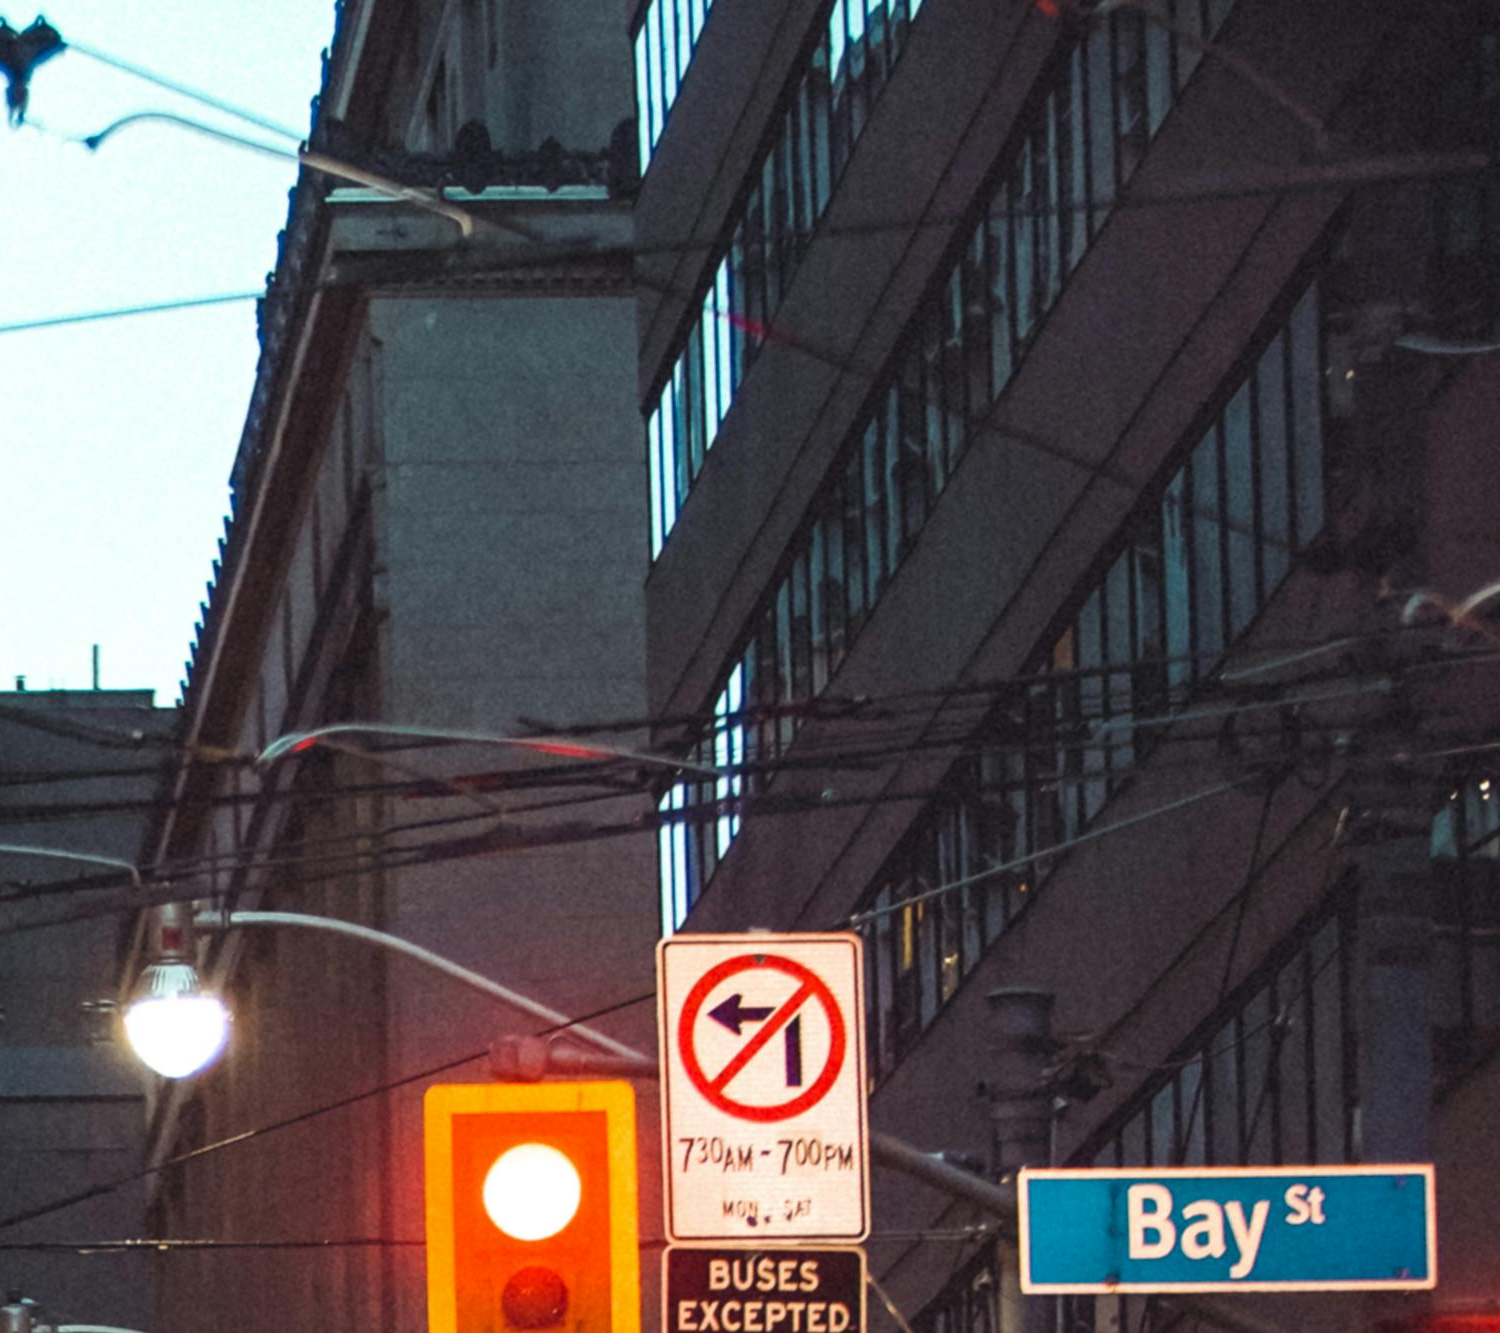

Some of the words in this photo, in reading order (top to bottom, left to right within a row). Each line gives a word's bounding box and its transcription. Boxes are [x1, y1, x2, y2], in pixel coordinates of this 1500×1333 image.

[678, 1137, 754, 1173] 730AM
[776, 1138, 854, 1176] 700PM
[1127, 1183, 1271, 1279] Bay
[1284, 1183, 1326, 1225] St
[708, 1259, 820, 1292] BUSES
[677, 1301, 850, 1333] EXCEPTED
